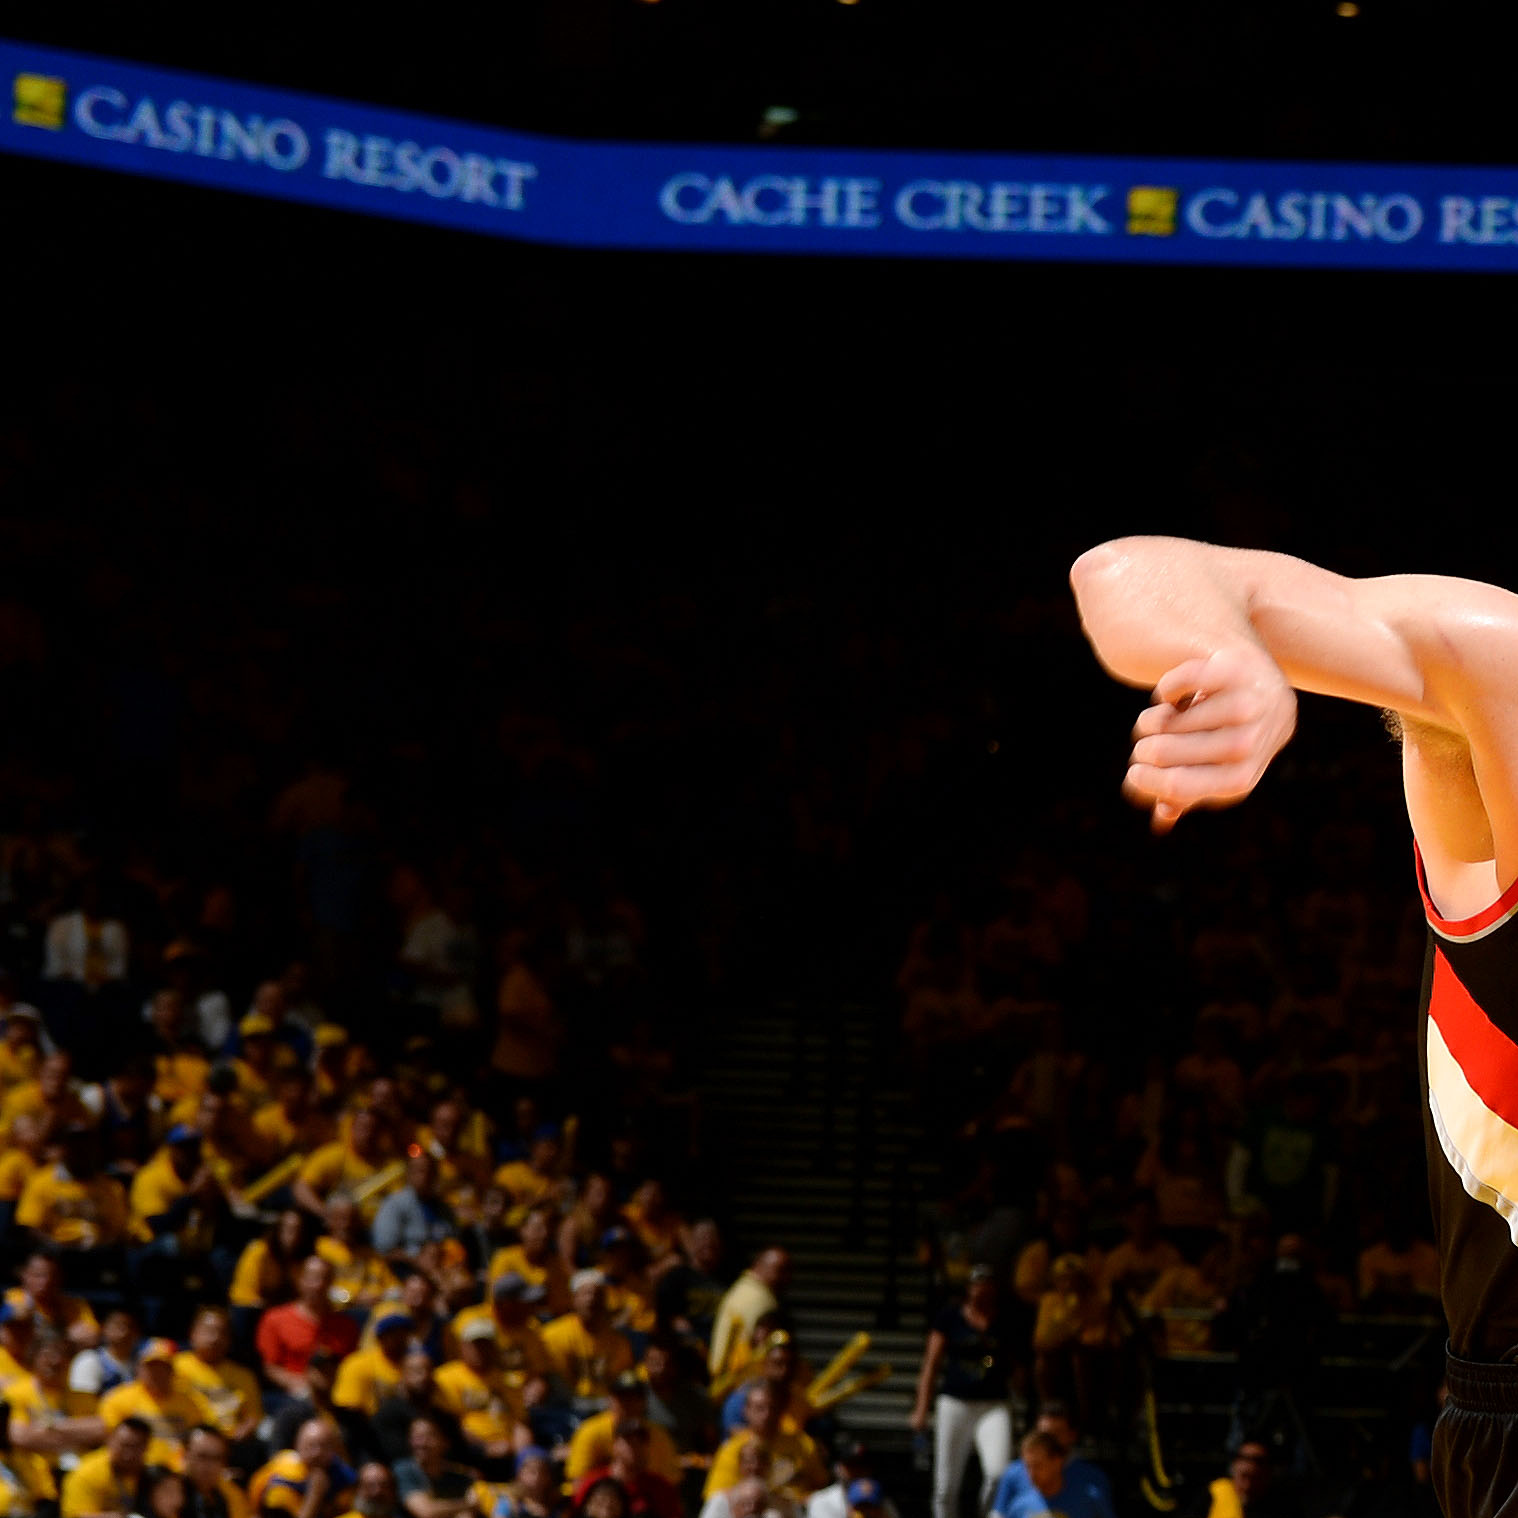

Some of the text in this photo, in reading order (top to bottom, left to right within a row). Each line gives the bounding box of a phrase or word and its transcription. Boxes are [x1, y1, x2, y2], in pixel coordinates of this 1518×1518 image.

[75, 85, 537, 211] CASINO RESORT
[658, 173, 882, 229] CACHE
[894, 178, 1113, 235] CREEK
[1185, 188, 1424, 243] CASINO
